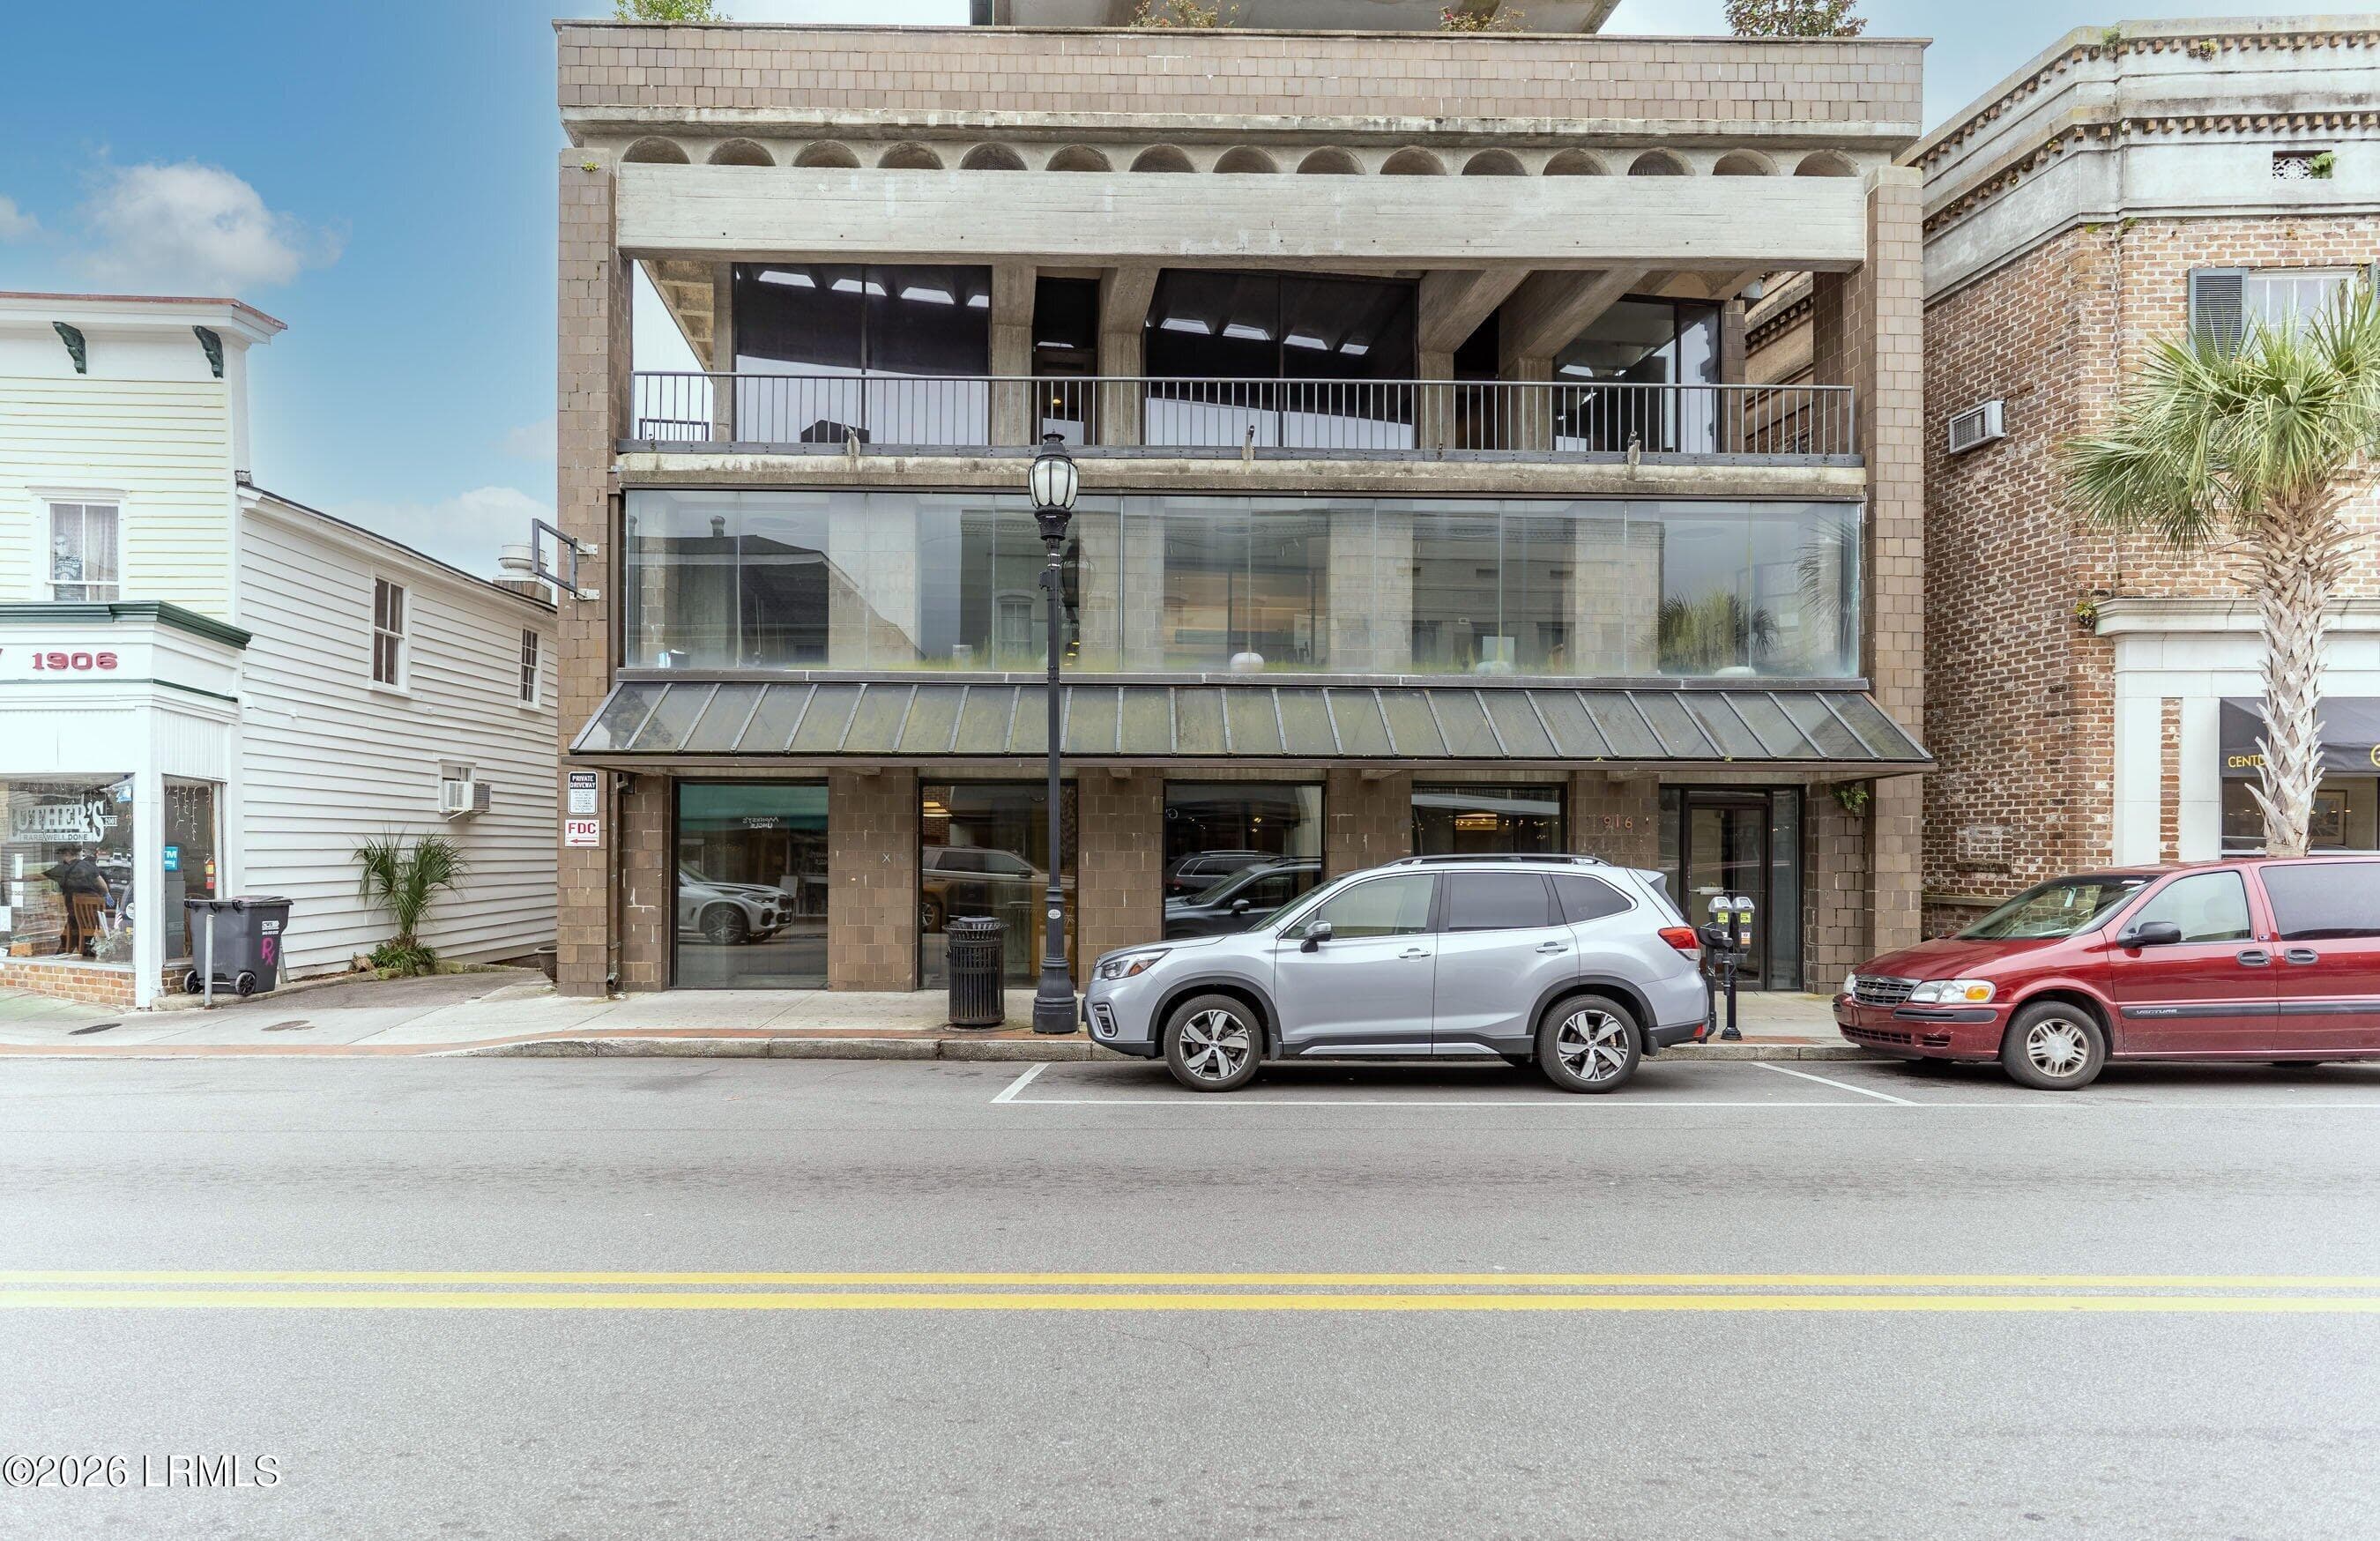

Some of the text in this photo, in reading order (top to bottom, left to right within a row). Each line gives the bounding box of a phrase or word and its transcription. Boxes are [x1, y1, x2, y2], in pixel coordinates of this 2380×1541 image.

[32, 652, 118, 670] 1906
[2228, 754, 2267, 768] CENTU
[7, 800, 105, 843] LUTHER'S
[568, 823, 597, 834] FDC
[1603, 814, 1633, 829] 916
